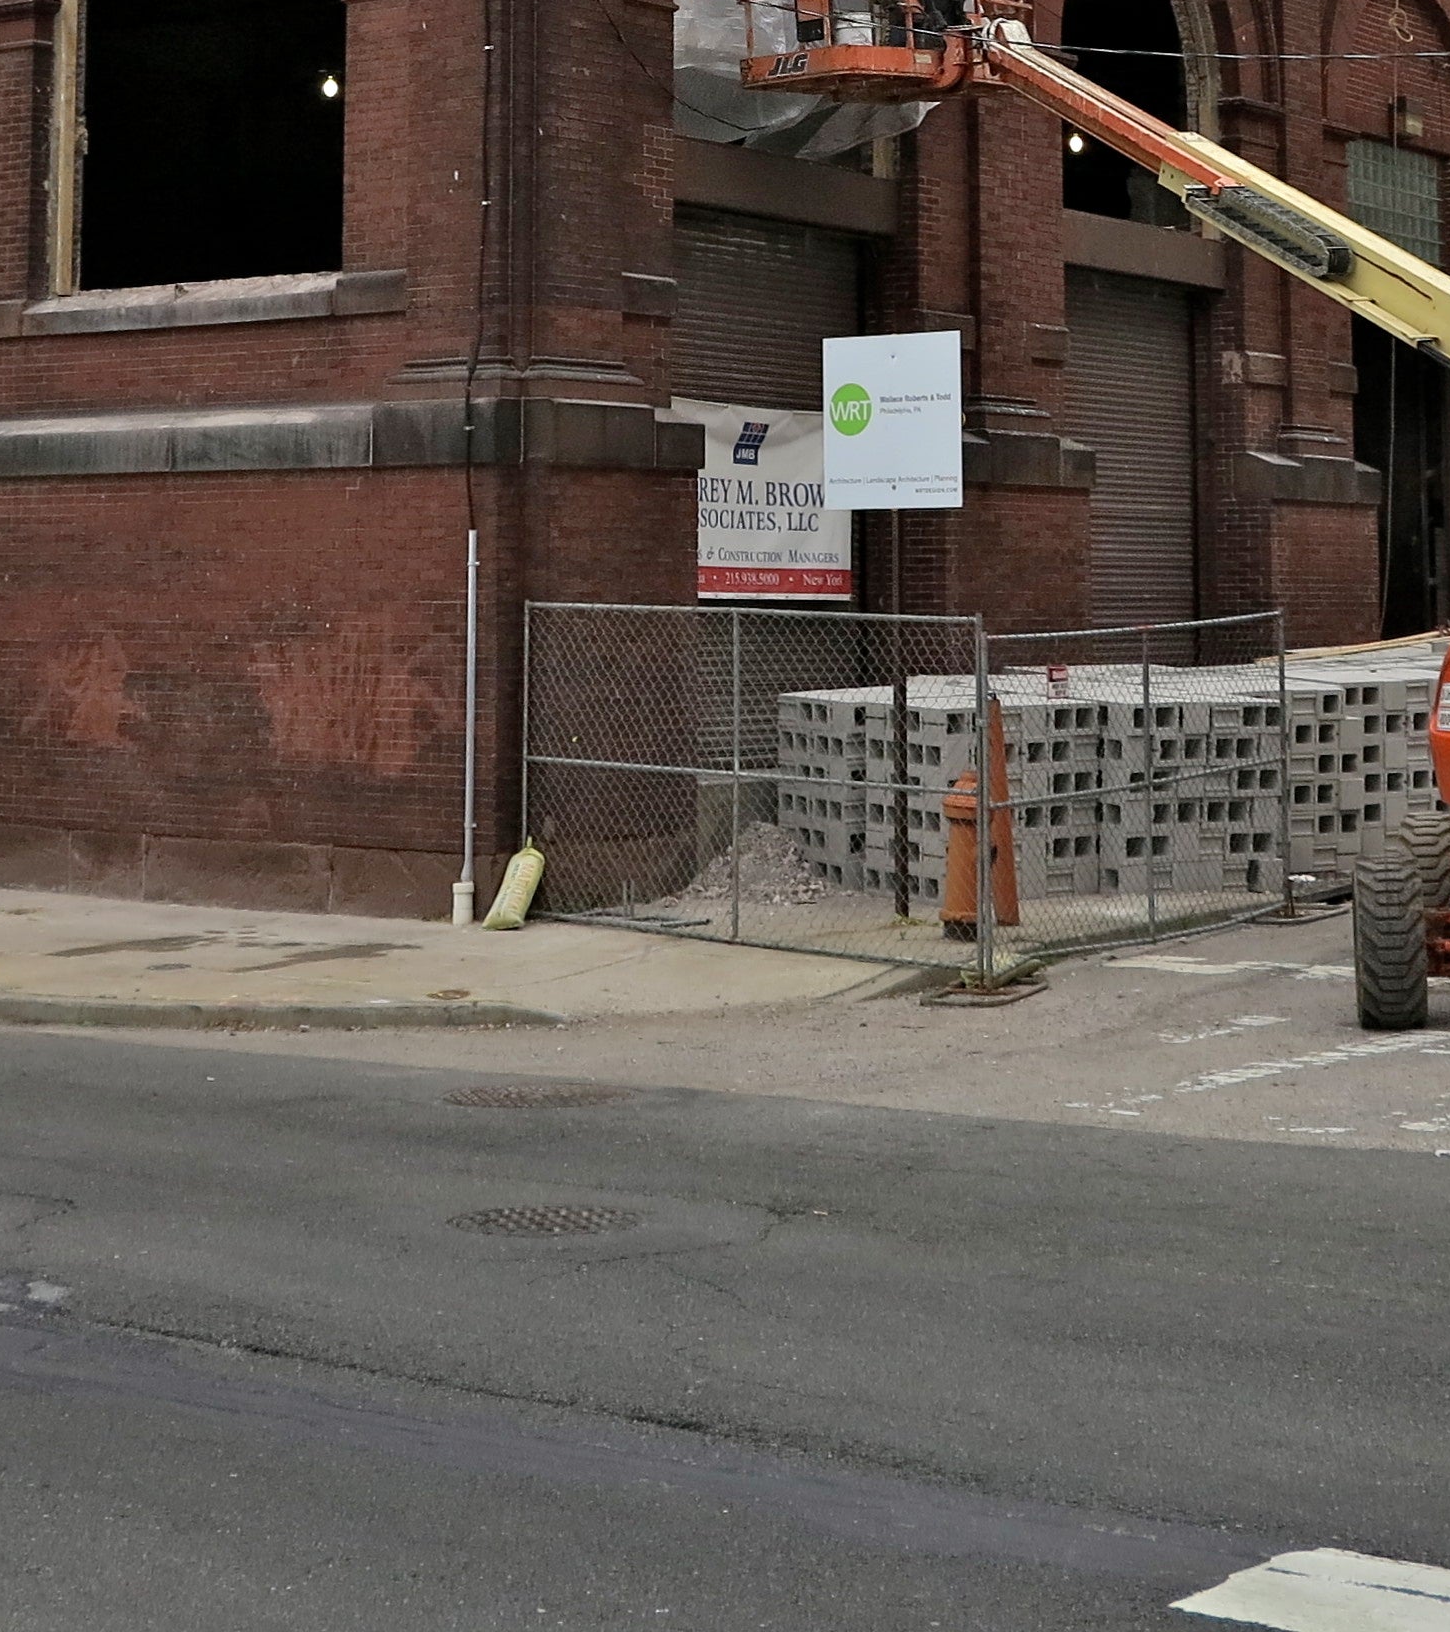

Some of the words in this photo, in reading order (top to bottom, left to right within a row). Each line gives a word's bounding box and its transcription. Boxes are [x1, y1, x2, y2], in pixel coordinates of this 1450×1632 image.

[765, 52, 810, 77] JLG
[904, 394, 928, 402] Roberts
[936, 393, 952, 401] Todd
[831, 399, 871, 422] WRT
[736, 448, 755, 460] JMB
[736, 479, 759, 505] M.
[700, 508, 782, 534] SOCIATES,
[787, 512, 820, 532] LLC
[706, 546, 715, 561] &
[788, 549, 840, 564] MANAGERS
[802, 573, 824, 586] New
